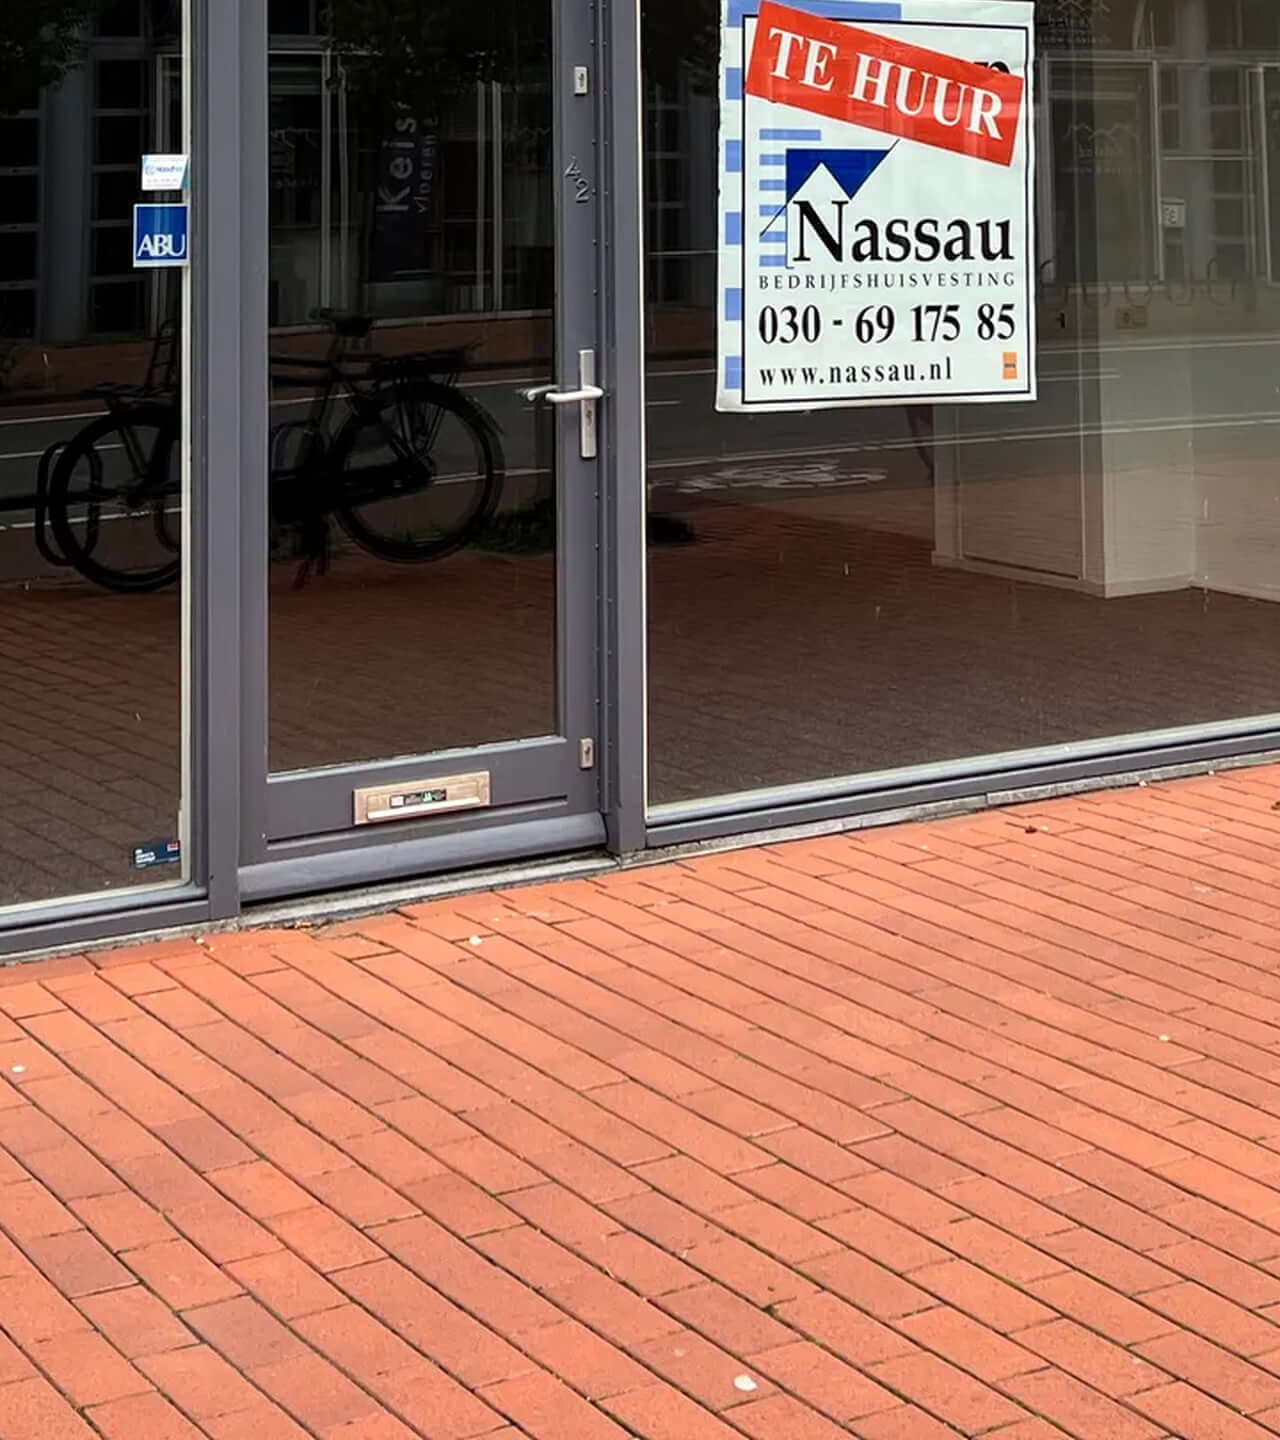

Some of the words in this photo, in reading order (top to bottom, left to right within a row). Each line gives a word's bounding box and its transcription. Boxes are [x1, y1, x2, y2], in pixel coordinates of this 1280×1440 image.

[768, 27, 838, 91] TE
[848, 52, 1004, 141] HUUR
[137, 234, 186, 257] ABU
[793, 200, 1015, 263] Nassau
[758, 271, 1016, 293] BEDRIJFSHUISVESTING
[758, 304, 821, 344] 030
[855, 305, 895, 344] 69
[910, 304, 961, 342] 175
[977, 303, 1016, 341] 85
[759, 356, 952, 385] www.nassau.nl
